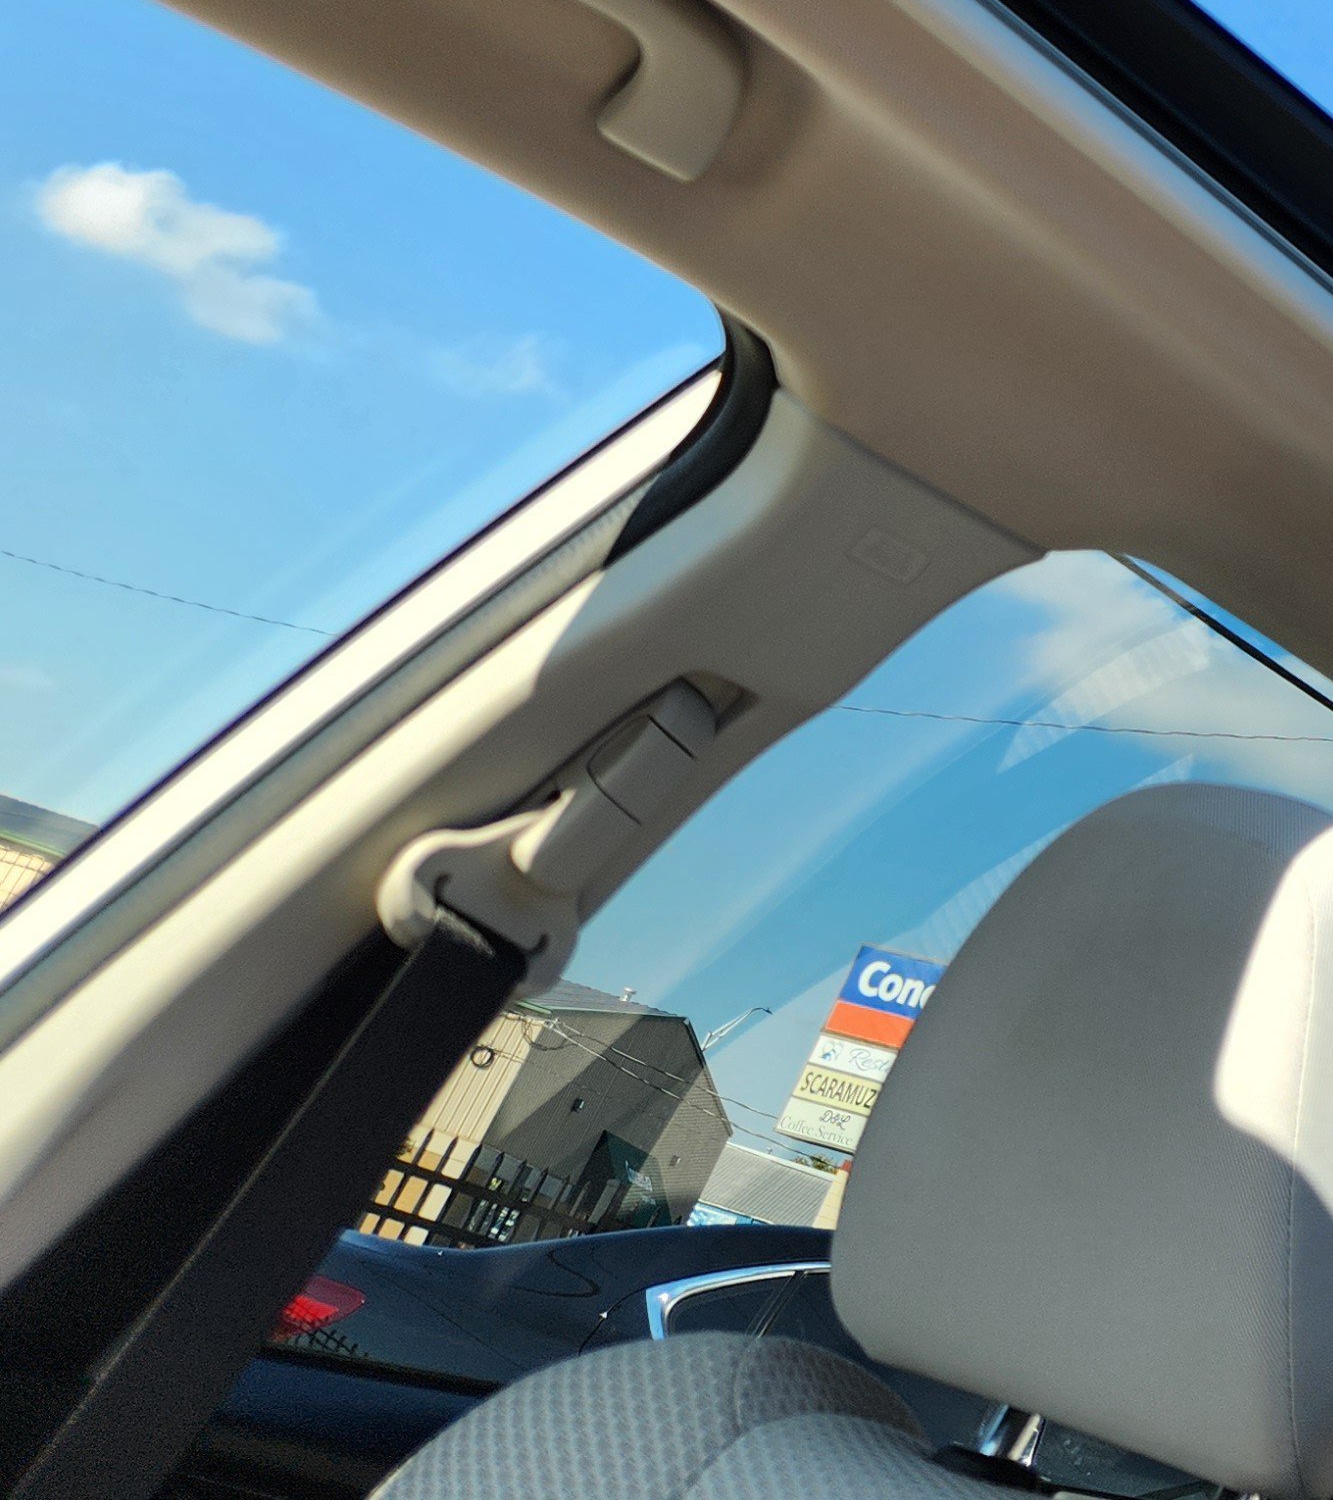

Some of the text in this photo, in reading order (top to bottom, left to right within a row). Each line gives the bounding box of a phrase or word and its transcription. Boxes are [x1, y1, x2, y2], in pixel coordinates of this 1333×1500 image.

[800, 1071, 878, 1109] SCARAMUZ
[780, 1115, 853, 1146] Coffee Service
